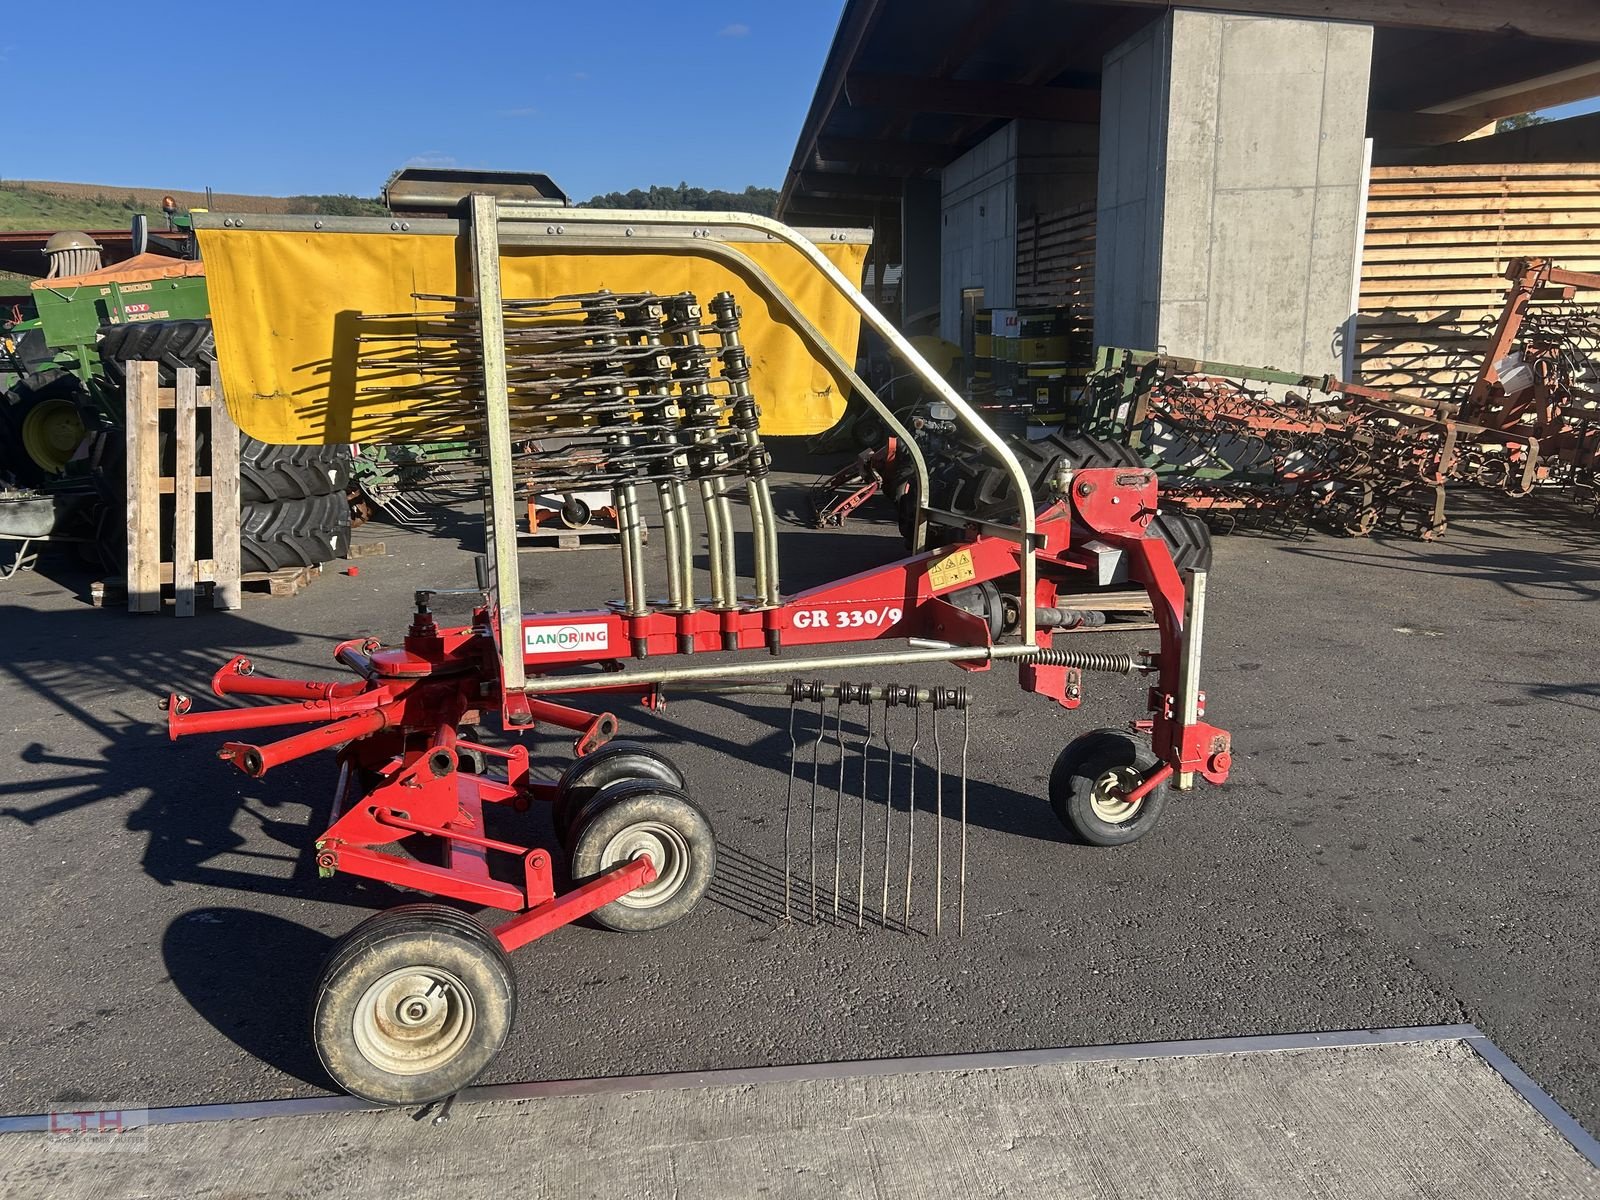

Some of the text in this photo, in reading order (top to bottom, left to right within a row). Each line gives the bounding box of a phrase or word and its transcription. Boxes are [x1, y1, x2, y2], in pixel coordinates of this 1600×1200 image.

[108, 310, 170, 324] MZONE
[793, 606, 903, 629] GR 330/9
[527, 631, 606, 646] LANDRING
